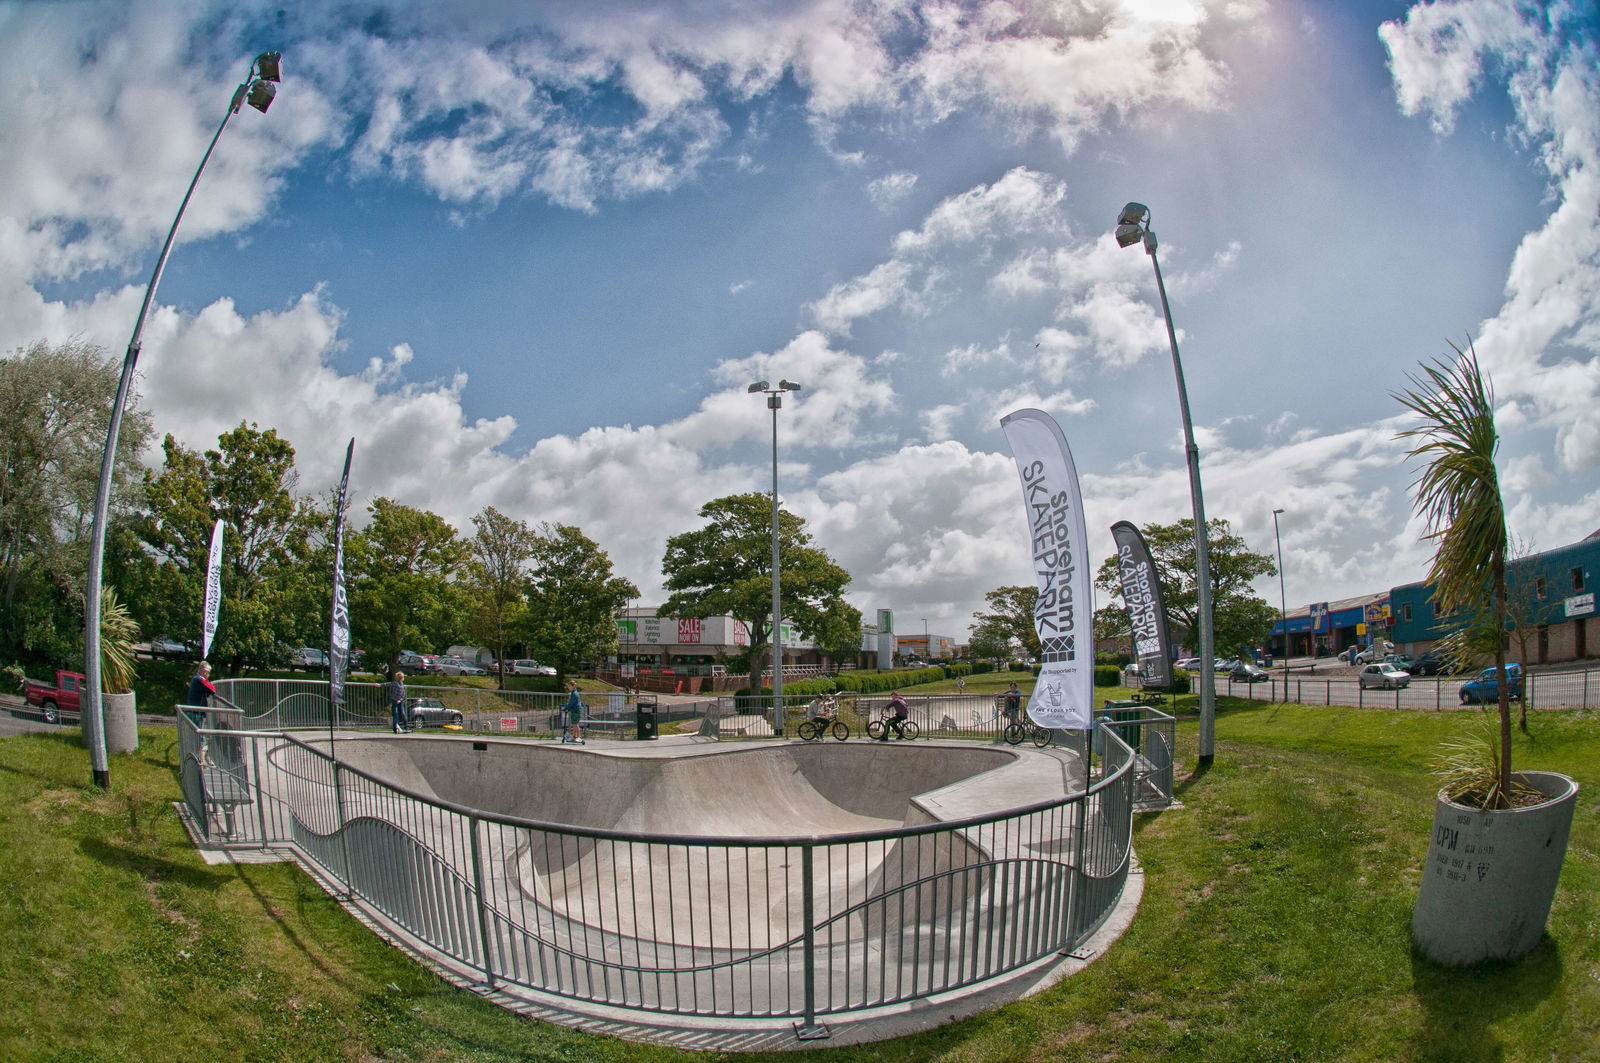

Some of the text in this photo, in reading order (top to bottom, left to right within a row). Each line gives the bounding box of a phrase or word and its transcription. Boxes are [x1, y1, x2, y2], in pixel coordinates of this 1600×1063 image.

[1022, 460, 1059, 636] SKATEPARK
[1050, 490, 1075, 633] Shoreham
[679, 618, 700, 633] SALE
[1119, 544, 1149, 642] SKATEPARK
[1136, 561, 1159, 638] Shoreham
[679, 633, 700, 642] NOW ON
[1436, 825, 1459, 851] CPM
